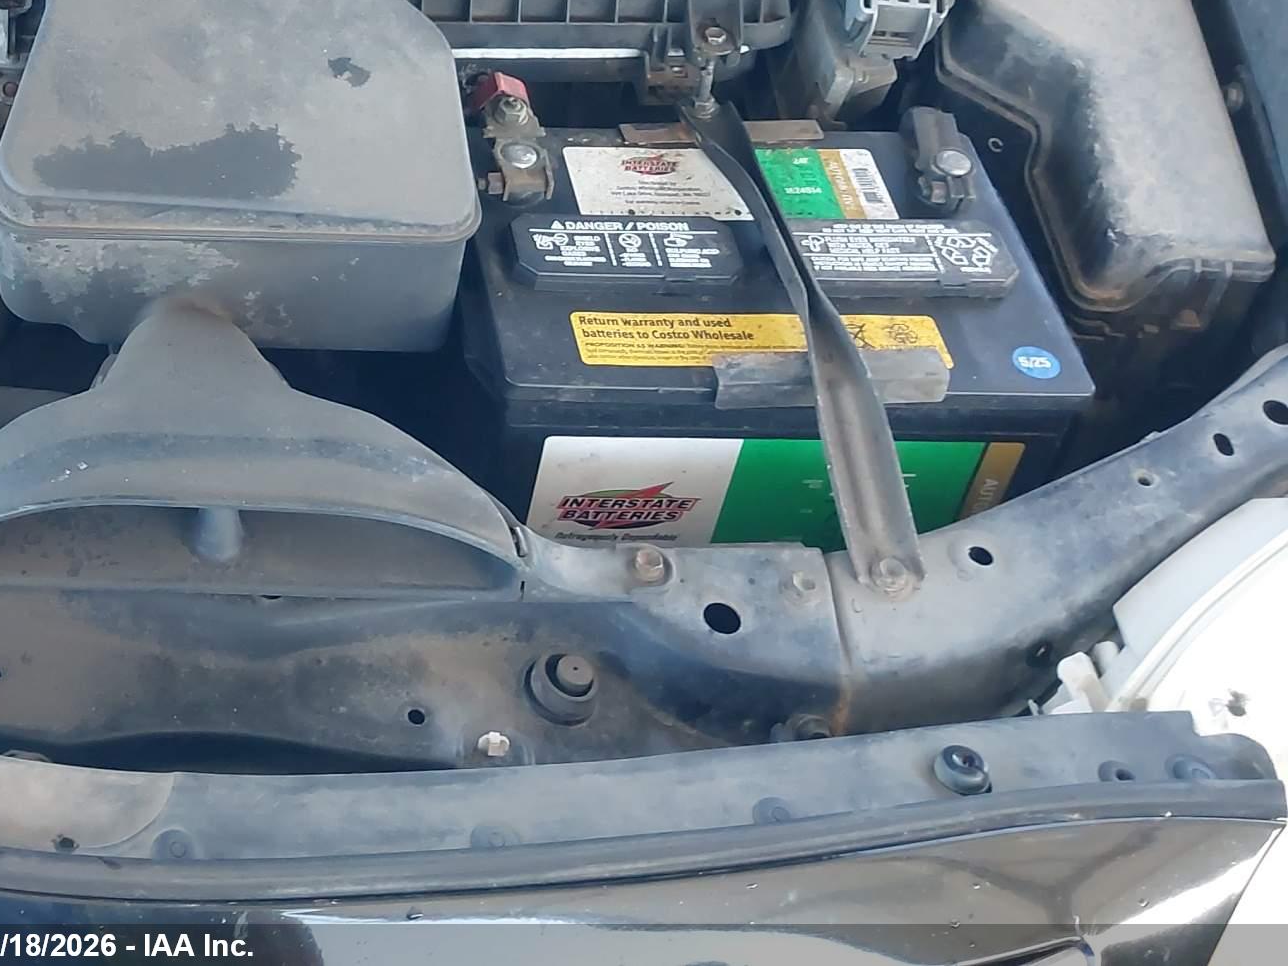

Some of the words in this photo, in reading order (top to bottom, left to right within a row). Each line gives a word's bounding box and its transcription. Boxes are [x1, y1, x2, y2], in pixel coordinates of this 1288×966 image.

[564, 221, 623, 231] DANGER
[637, 222, 690, 232] POISON
[578, 315, 618, 326] Return
[622, 317, 675, 329] warranty
[678, 317, 700, 327] and
[702, 317, 732, 328] used
[582, 328, 635, 339] batteries
[636, 330, 649, 339] to
[651, 329, 689, 340] Costco
[691, 330, 755, 341] Wholesale
[562, 497, 693, 510] INTERSTATE
[563, 510, 679, 521] BATTERIES
